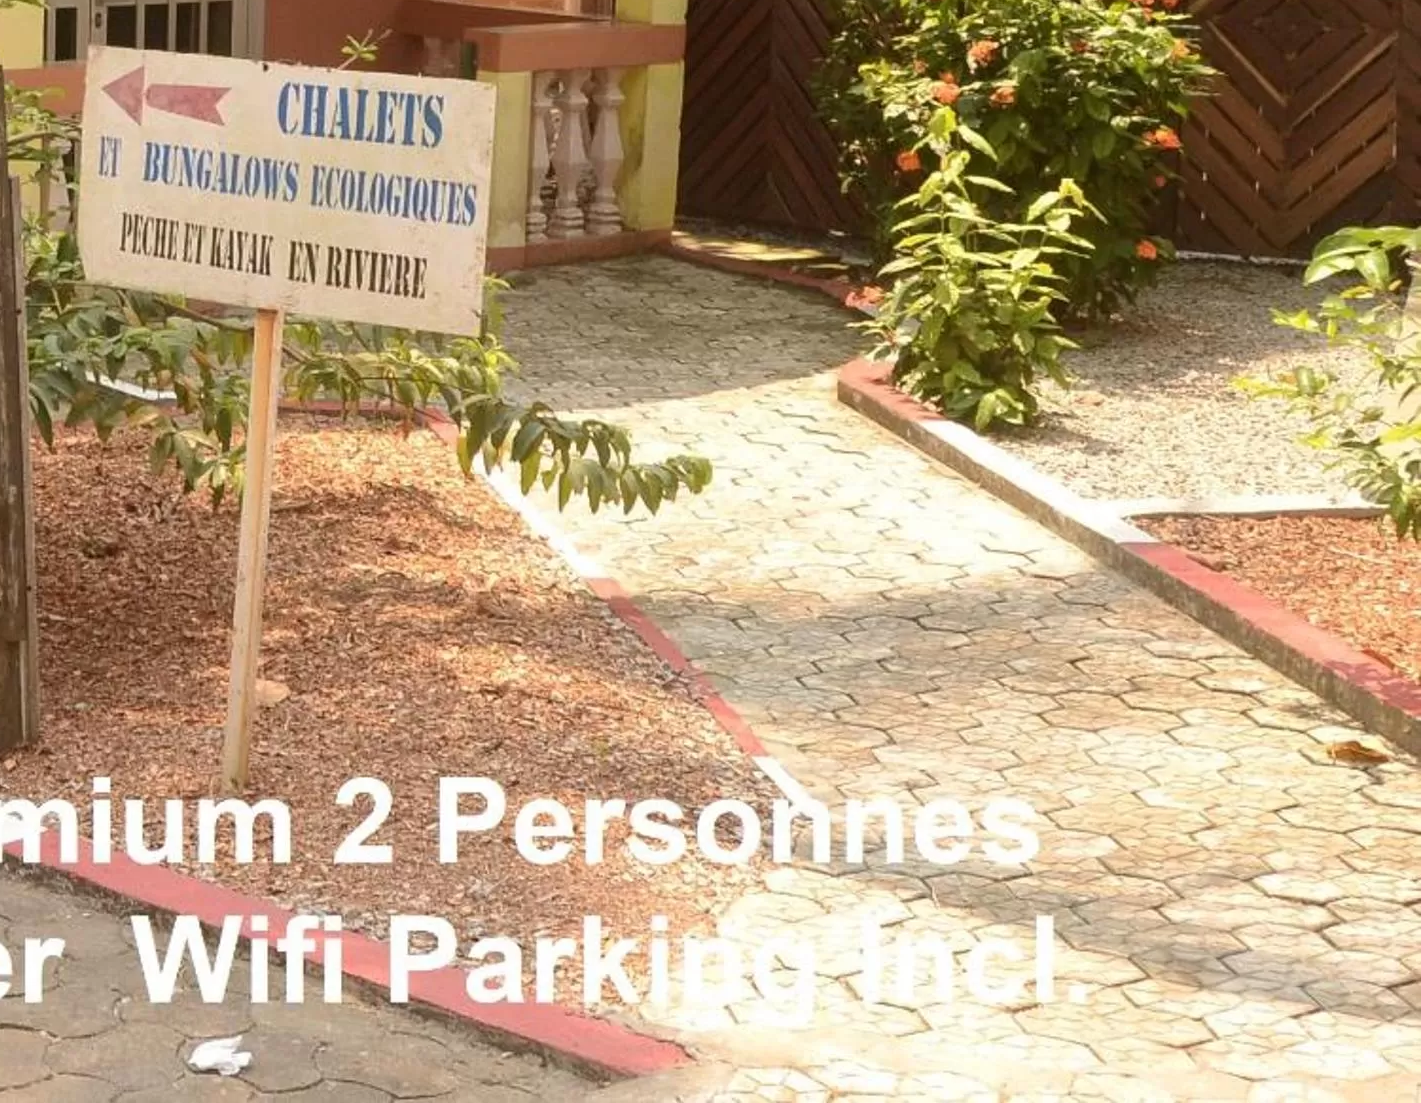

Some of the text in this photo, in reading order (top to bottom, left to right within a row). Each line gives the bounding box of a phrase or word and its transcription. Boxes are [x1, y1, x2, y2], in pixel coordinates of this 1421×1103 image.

[278, 82, 446, 148] CHALETS
[98, 135, 477, 227] ET BUNGALOWS ECOLOGIQUES
[119, 212, 428, 299] PECHE ET KAYAK EN RIVIERE
